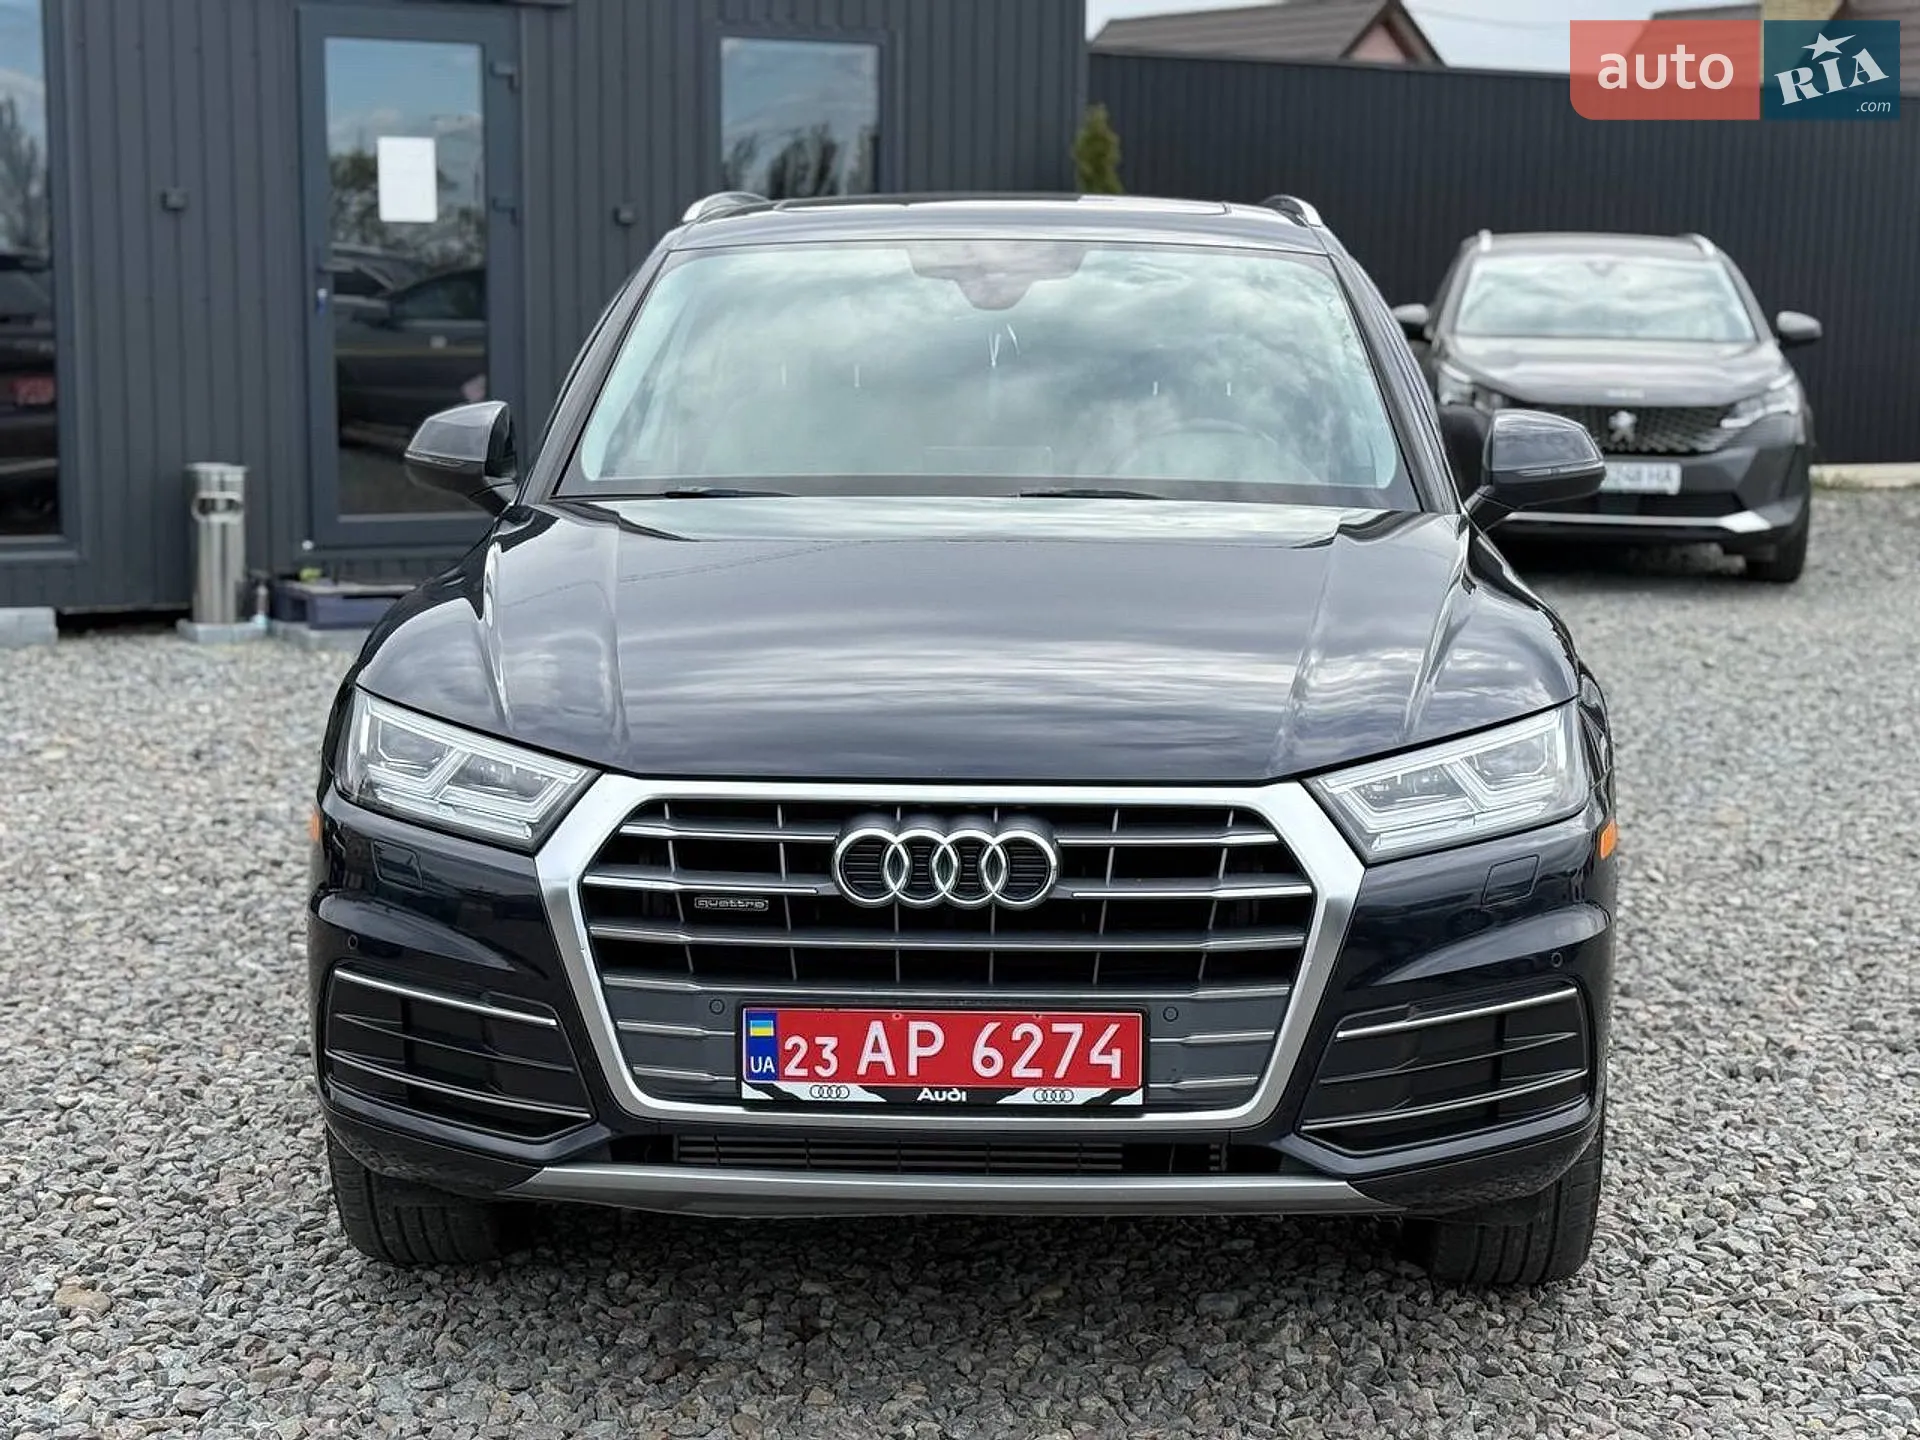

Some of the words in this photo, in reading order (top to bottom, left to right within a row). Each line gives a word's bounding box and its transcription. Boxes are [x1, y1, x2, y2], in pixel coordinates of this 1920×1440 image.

[698, 900, 765, 909] quattro
[784, 1035, 838, 1077] 23
[857, 1020, 945, 1076] AP
[972, 1021, 1122, 1080] 6274
[750, 1056, 776, 1074] UA
[917, 1087, 967, 1102] Audi
